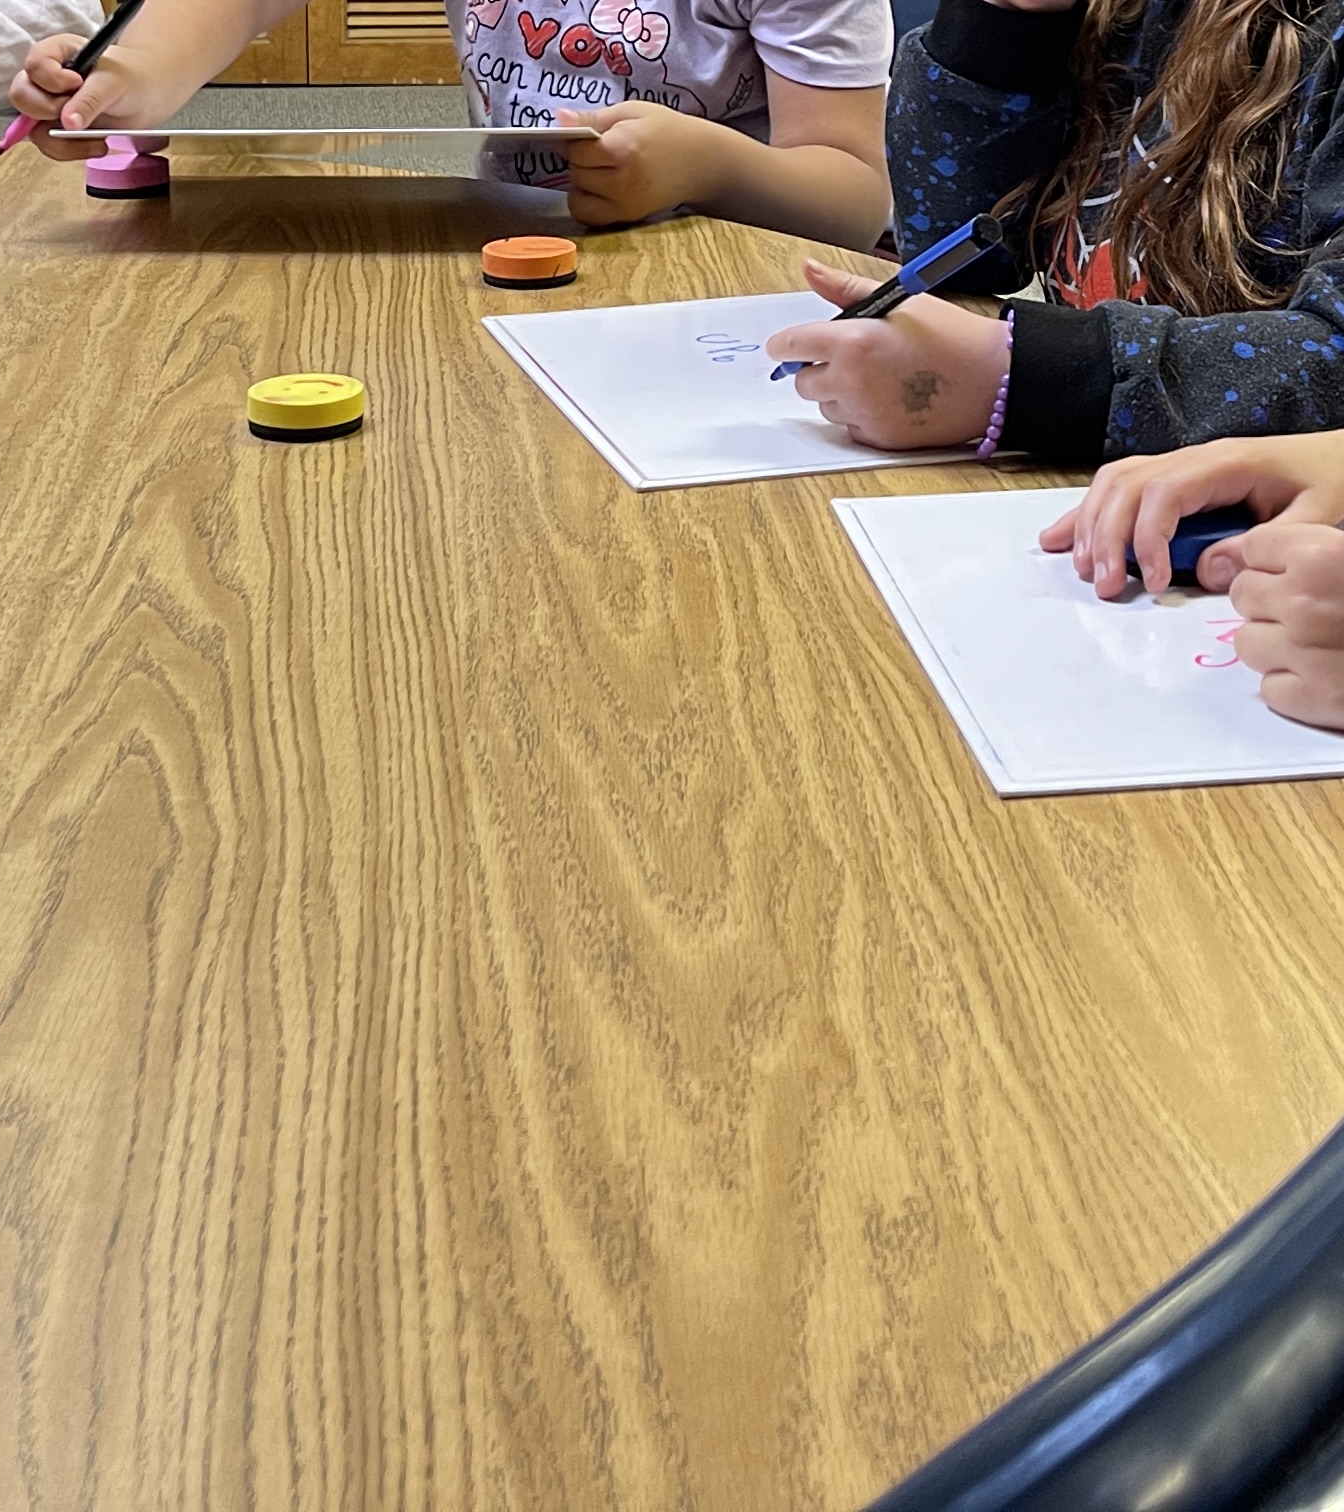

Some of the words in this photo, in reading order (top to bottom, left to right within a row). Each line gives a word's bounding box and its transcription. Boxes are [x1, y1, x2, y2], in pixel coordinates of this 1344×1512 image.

[477, 52, 528, 89] can
[537, 68, 615, 106] never
[509, 93, 556, 128] too
